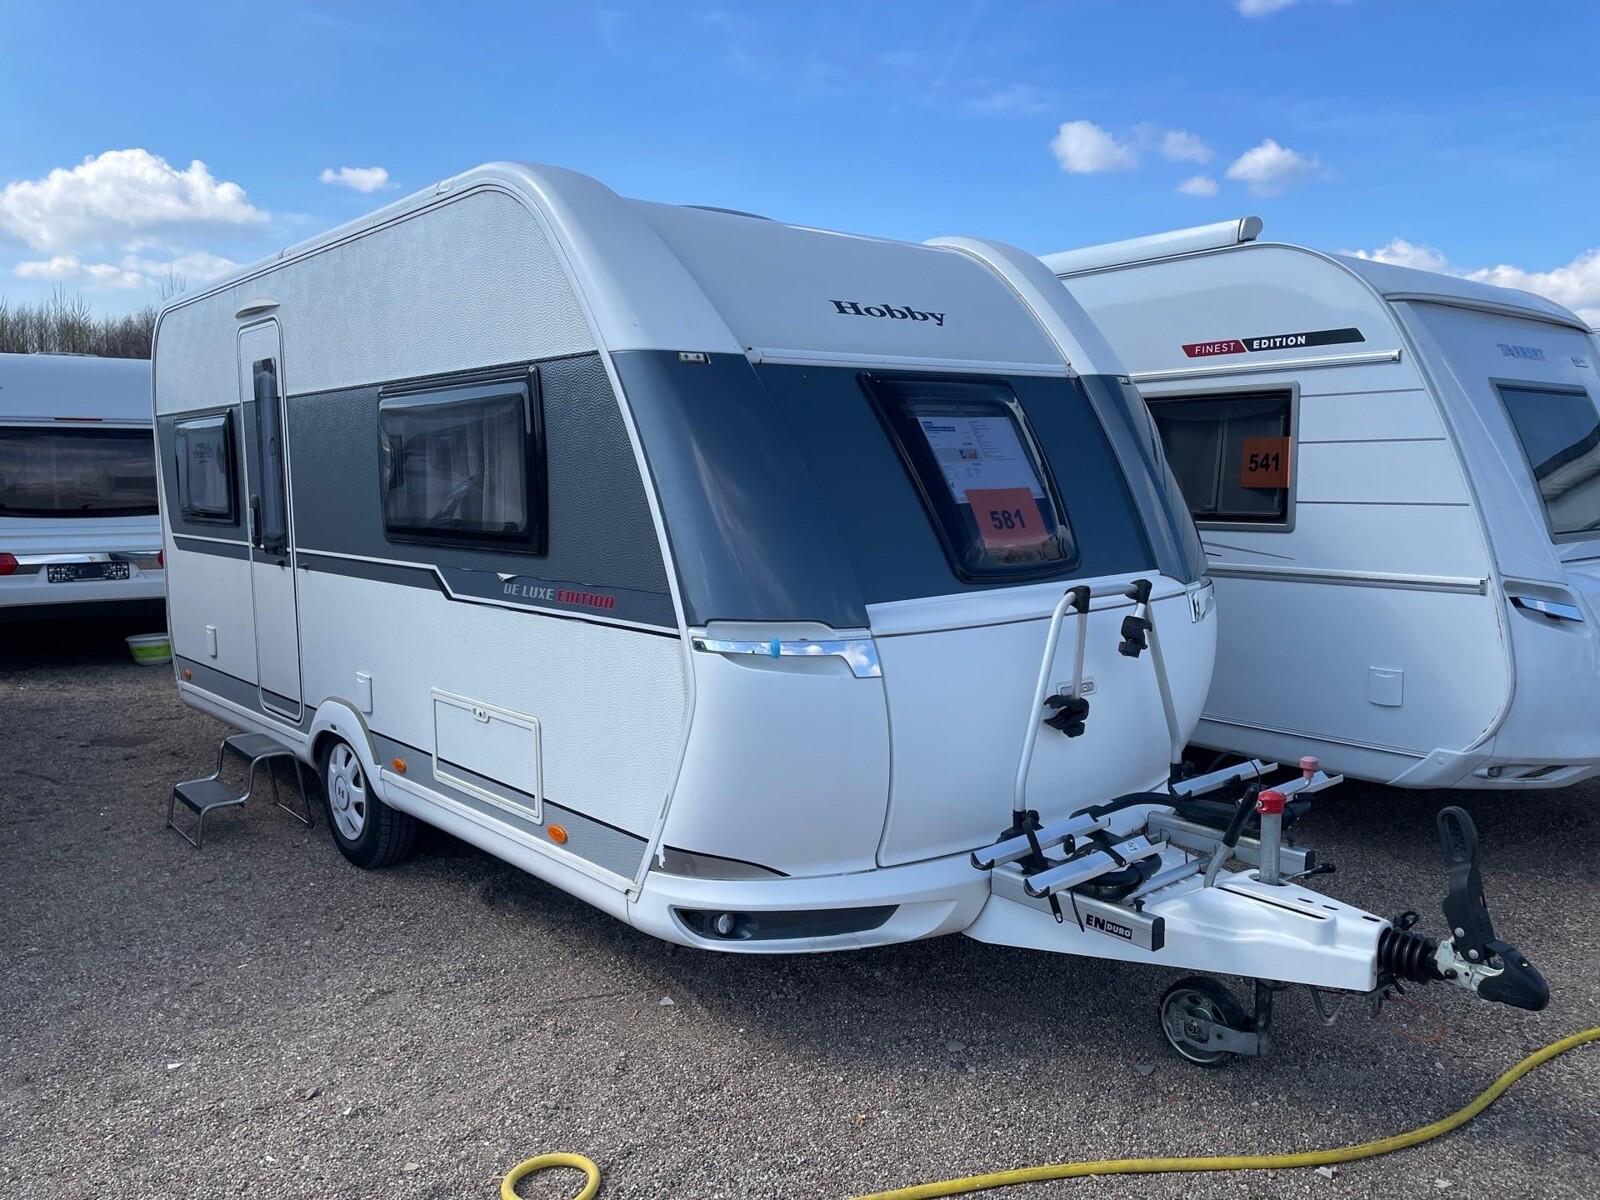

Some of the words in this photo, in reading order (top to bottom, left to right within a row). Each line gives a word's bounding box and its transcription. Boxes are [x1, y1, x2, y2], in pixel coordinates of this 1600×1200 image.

[828, 300, 945, 326] Hobby
[1195, 342, 1236, 355] FINEST
[1253, 335, 1306, 349] EDITION
[1248, 452, 1280, 472] 541
[989, 509, 1026, 530] 581
[503, 583, 519, 596] DE
[522, 585, 554, 601] LUXE
